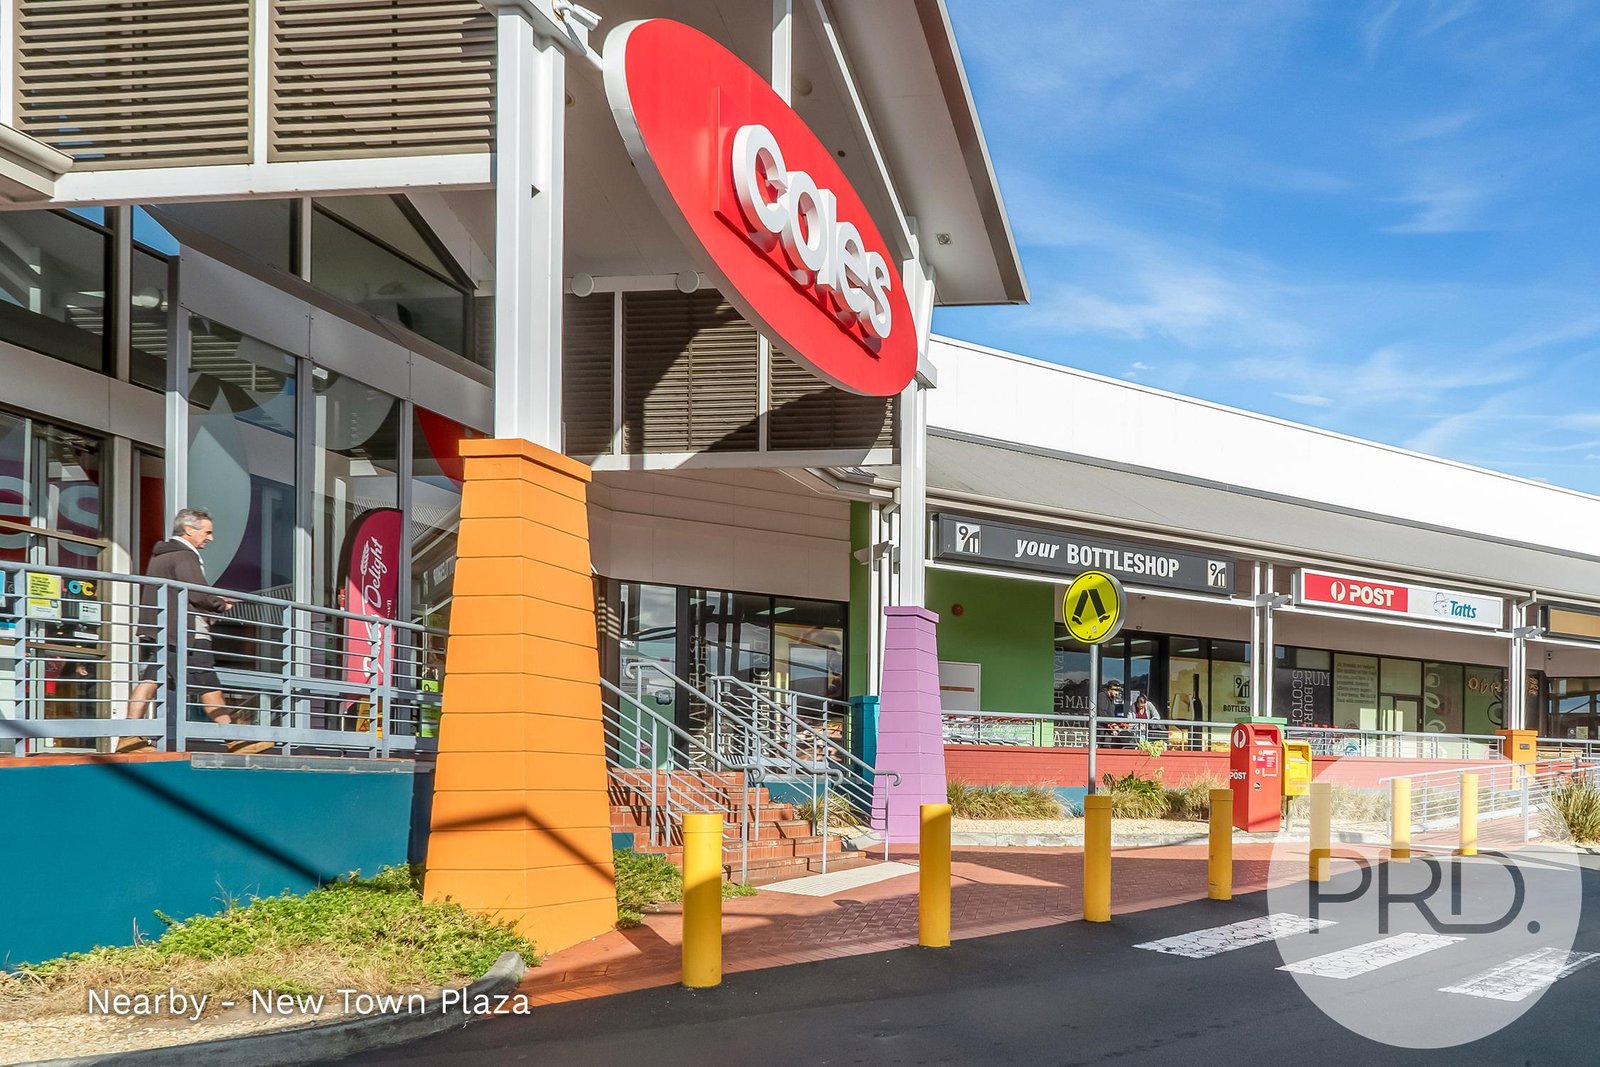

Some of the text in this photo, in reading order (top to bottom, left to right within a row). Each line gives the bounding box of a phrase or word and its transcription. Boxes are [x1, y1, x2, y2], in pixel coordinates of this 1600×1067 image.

[1014, 538, 1180, 578] your BOTTLESHOP
[364, 536, 388, 609] Delight
[1350, 584, 1394, 607] POST
[1450, 600, 1477, 619] Tatts
[1304, 670, 1331, 687] RUM
[1229, 771, 1247, 780] POST
